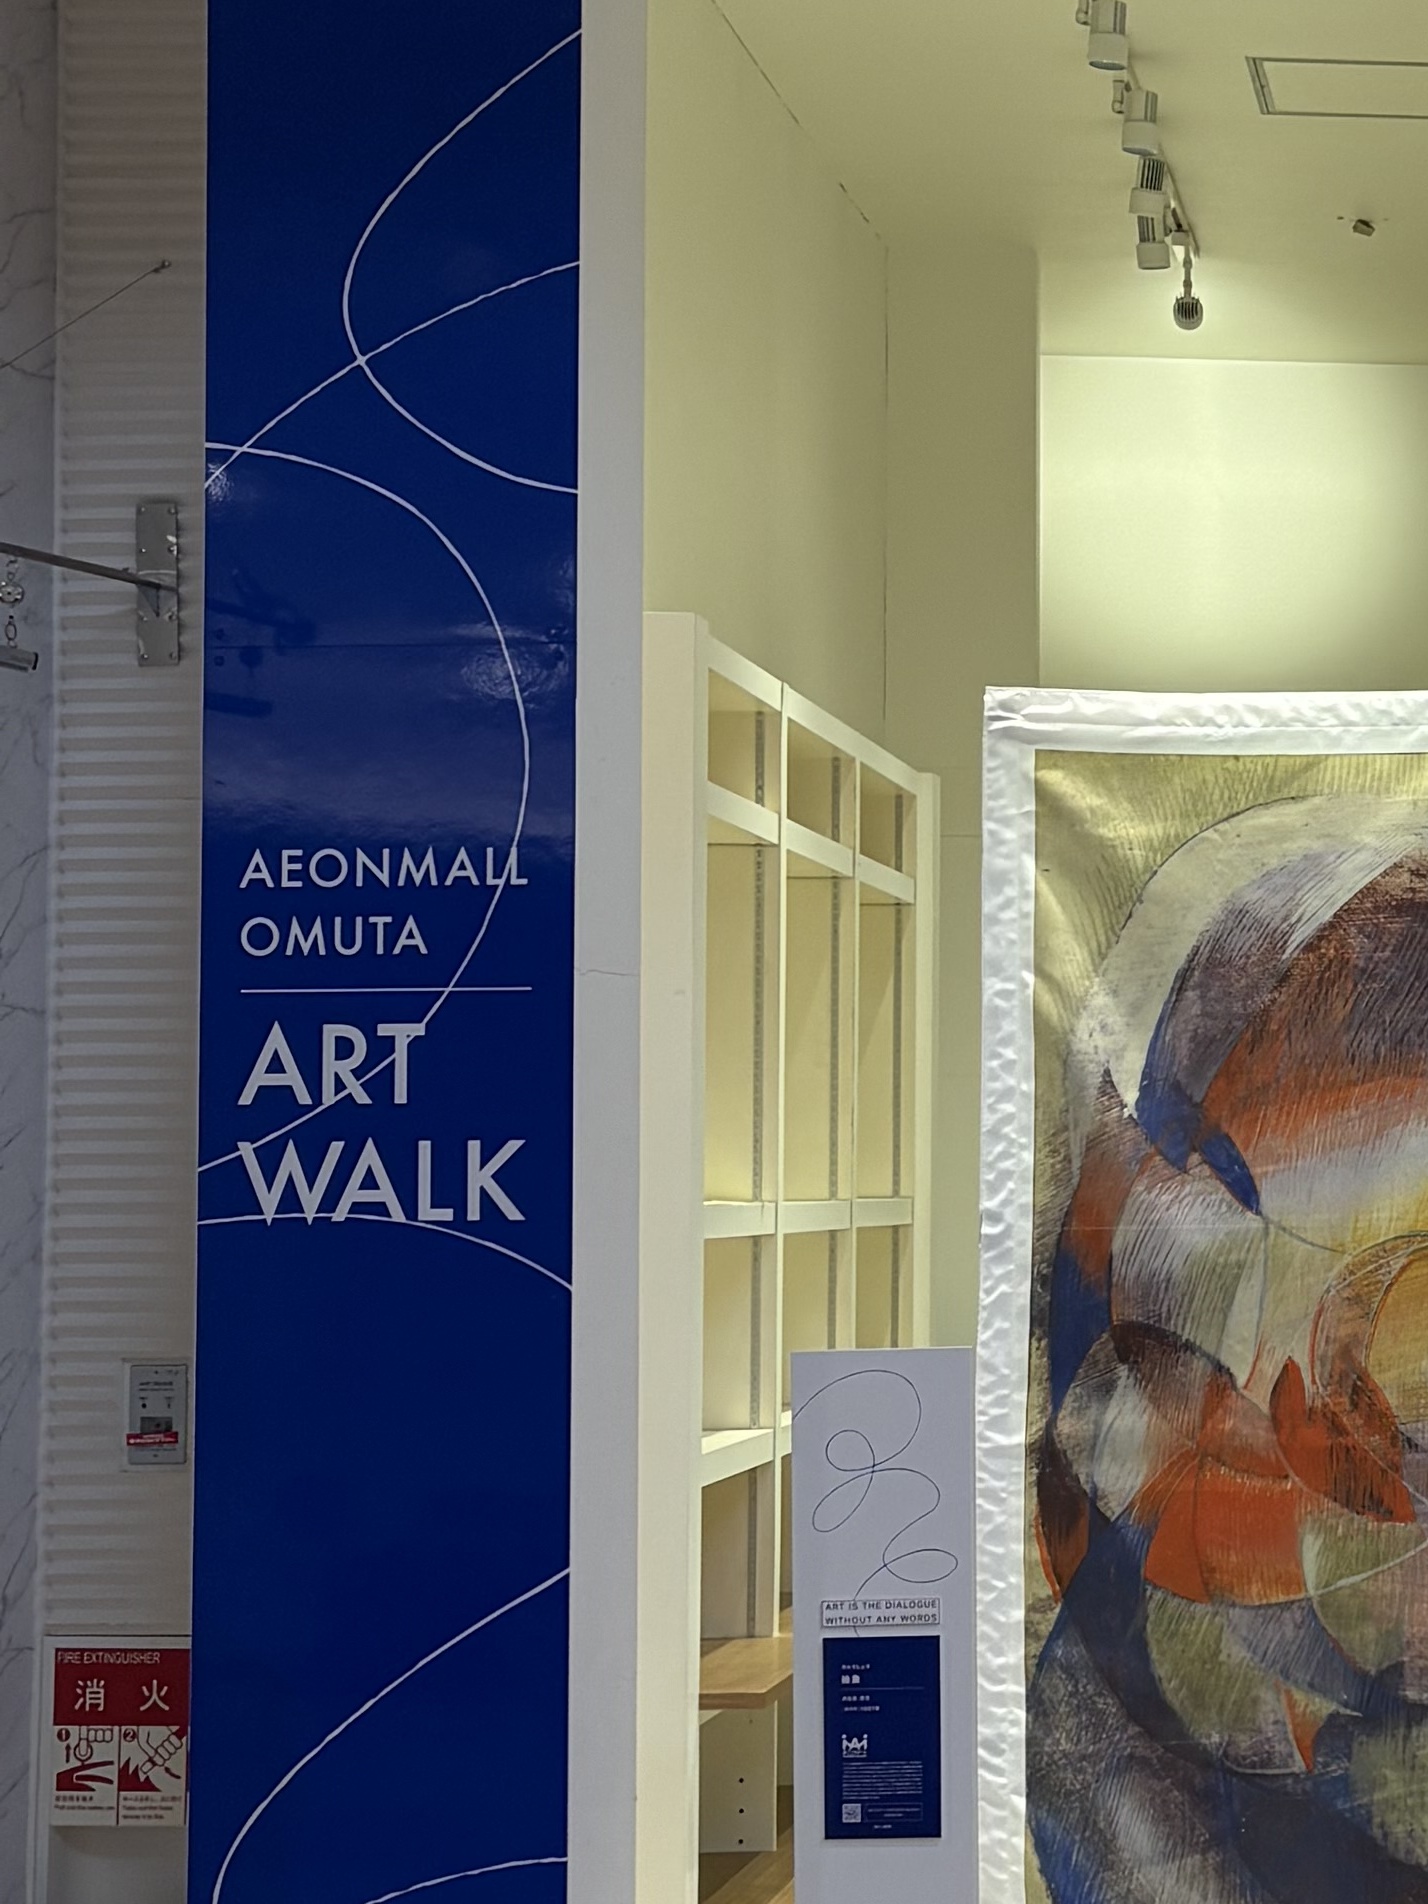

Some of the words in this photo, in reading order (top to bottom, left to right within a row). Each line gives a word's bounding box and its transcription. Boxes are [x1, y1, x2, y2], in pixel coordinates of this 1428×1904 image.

[239, 846, 529, 889] AEONMALL
[240, 914, 428, 957] OMUTA
[237, 1020, 426, 1106] ART
[236, 1136, 527, 1226] WALK
[825, 1602, 845, 1611] ART
[848, 1601, 859, 1611] IS
[862, 1601, 882, 1610] THE
[885, 1599, 937, 1610] DIALOGUE
[825, 1616, 872, 1625] WITHOUT
[900, 1614, 937, 1623] WORDS
[56, 1651, 81, 1664] FIRE
[83, 1651, 161, 1665] EXTINGUISHER
